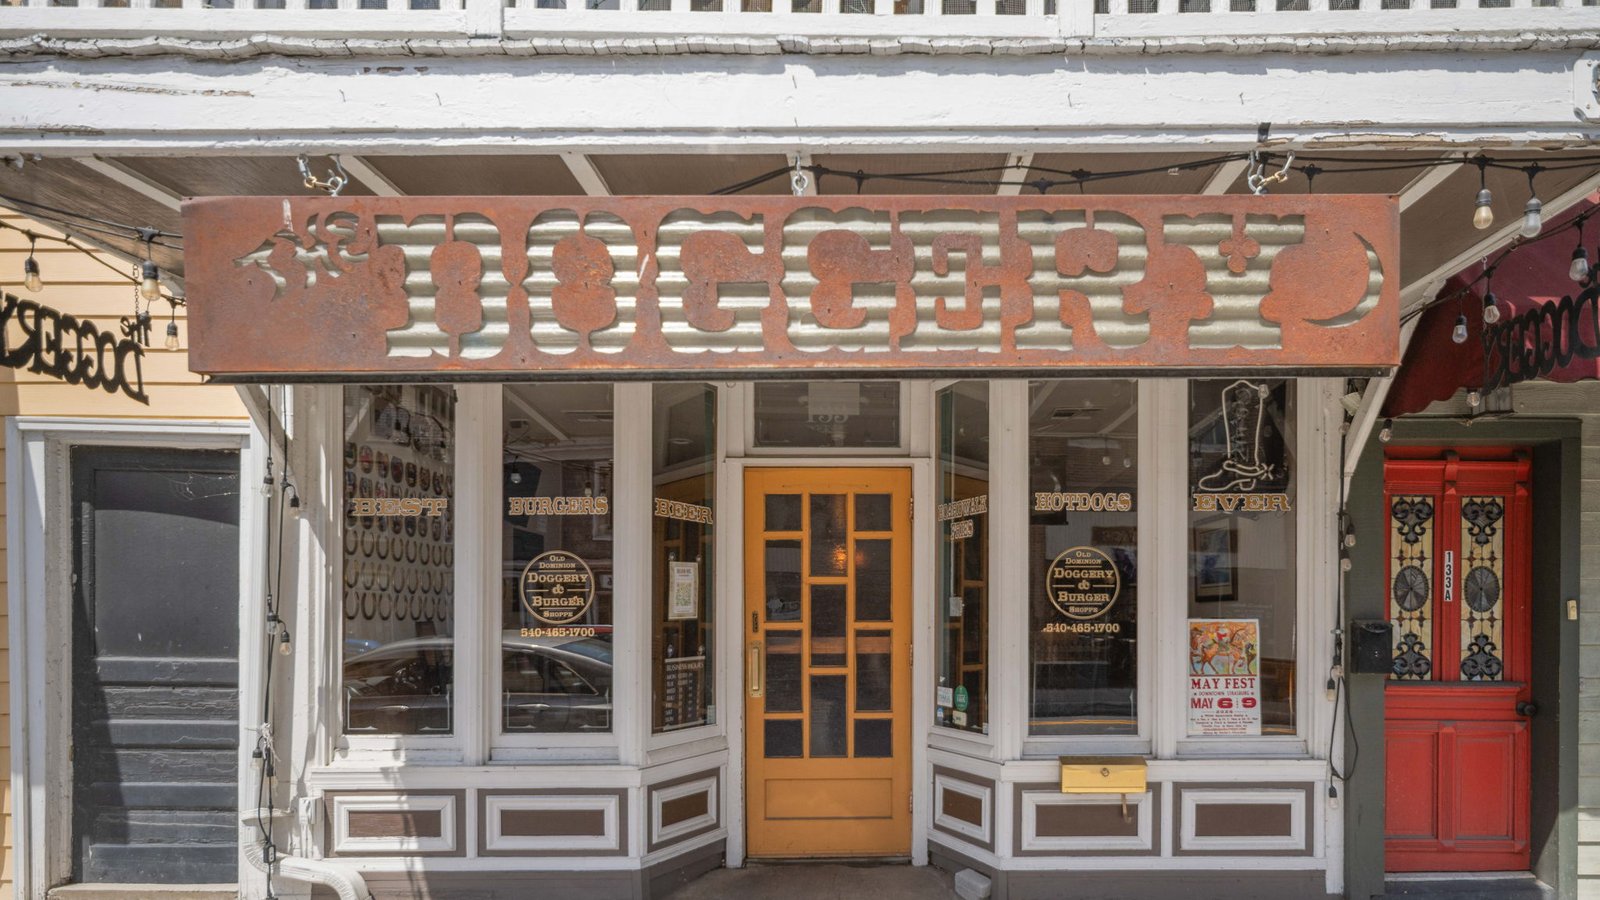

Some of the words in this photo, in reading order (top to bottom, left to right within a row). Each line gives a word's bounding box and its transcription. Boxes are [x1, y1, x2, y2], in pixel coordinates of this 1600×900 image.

[374, 207, 1306, 360] DOGGERY
[352, 498, 447, 516] BEST
[508, 496, 608, 516] BURGERS
[1035, 492, 1131, 512] HOTDOGS
[1193, 493, 1291, 511] EVER
[654, 497, 713, 525] BEER
[527, 573, 588, 583] DOGGERY
[1054, 568, 1114, 579] DOGGERY
[1445, 552, 1453, 600] 133A
[552, 584, 564, 594] &
[1078, 580, 1090, 590] &
[532, 596, 585, 606] BURGER
[1057, 591, 1110, 602] BURGER
[1191, 678, 1220, 689] MAY
[1224, 678, 1255, 689] FEST
[1190, 697, 1214, 709] MAY
[1217, 697, 1233, 709] 6
[1241, 697, 1257, 709] 9
